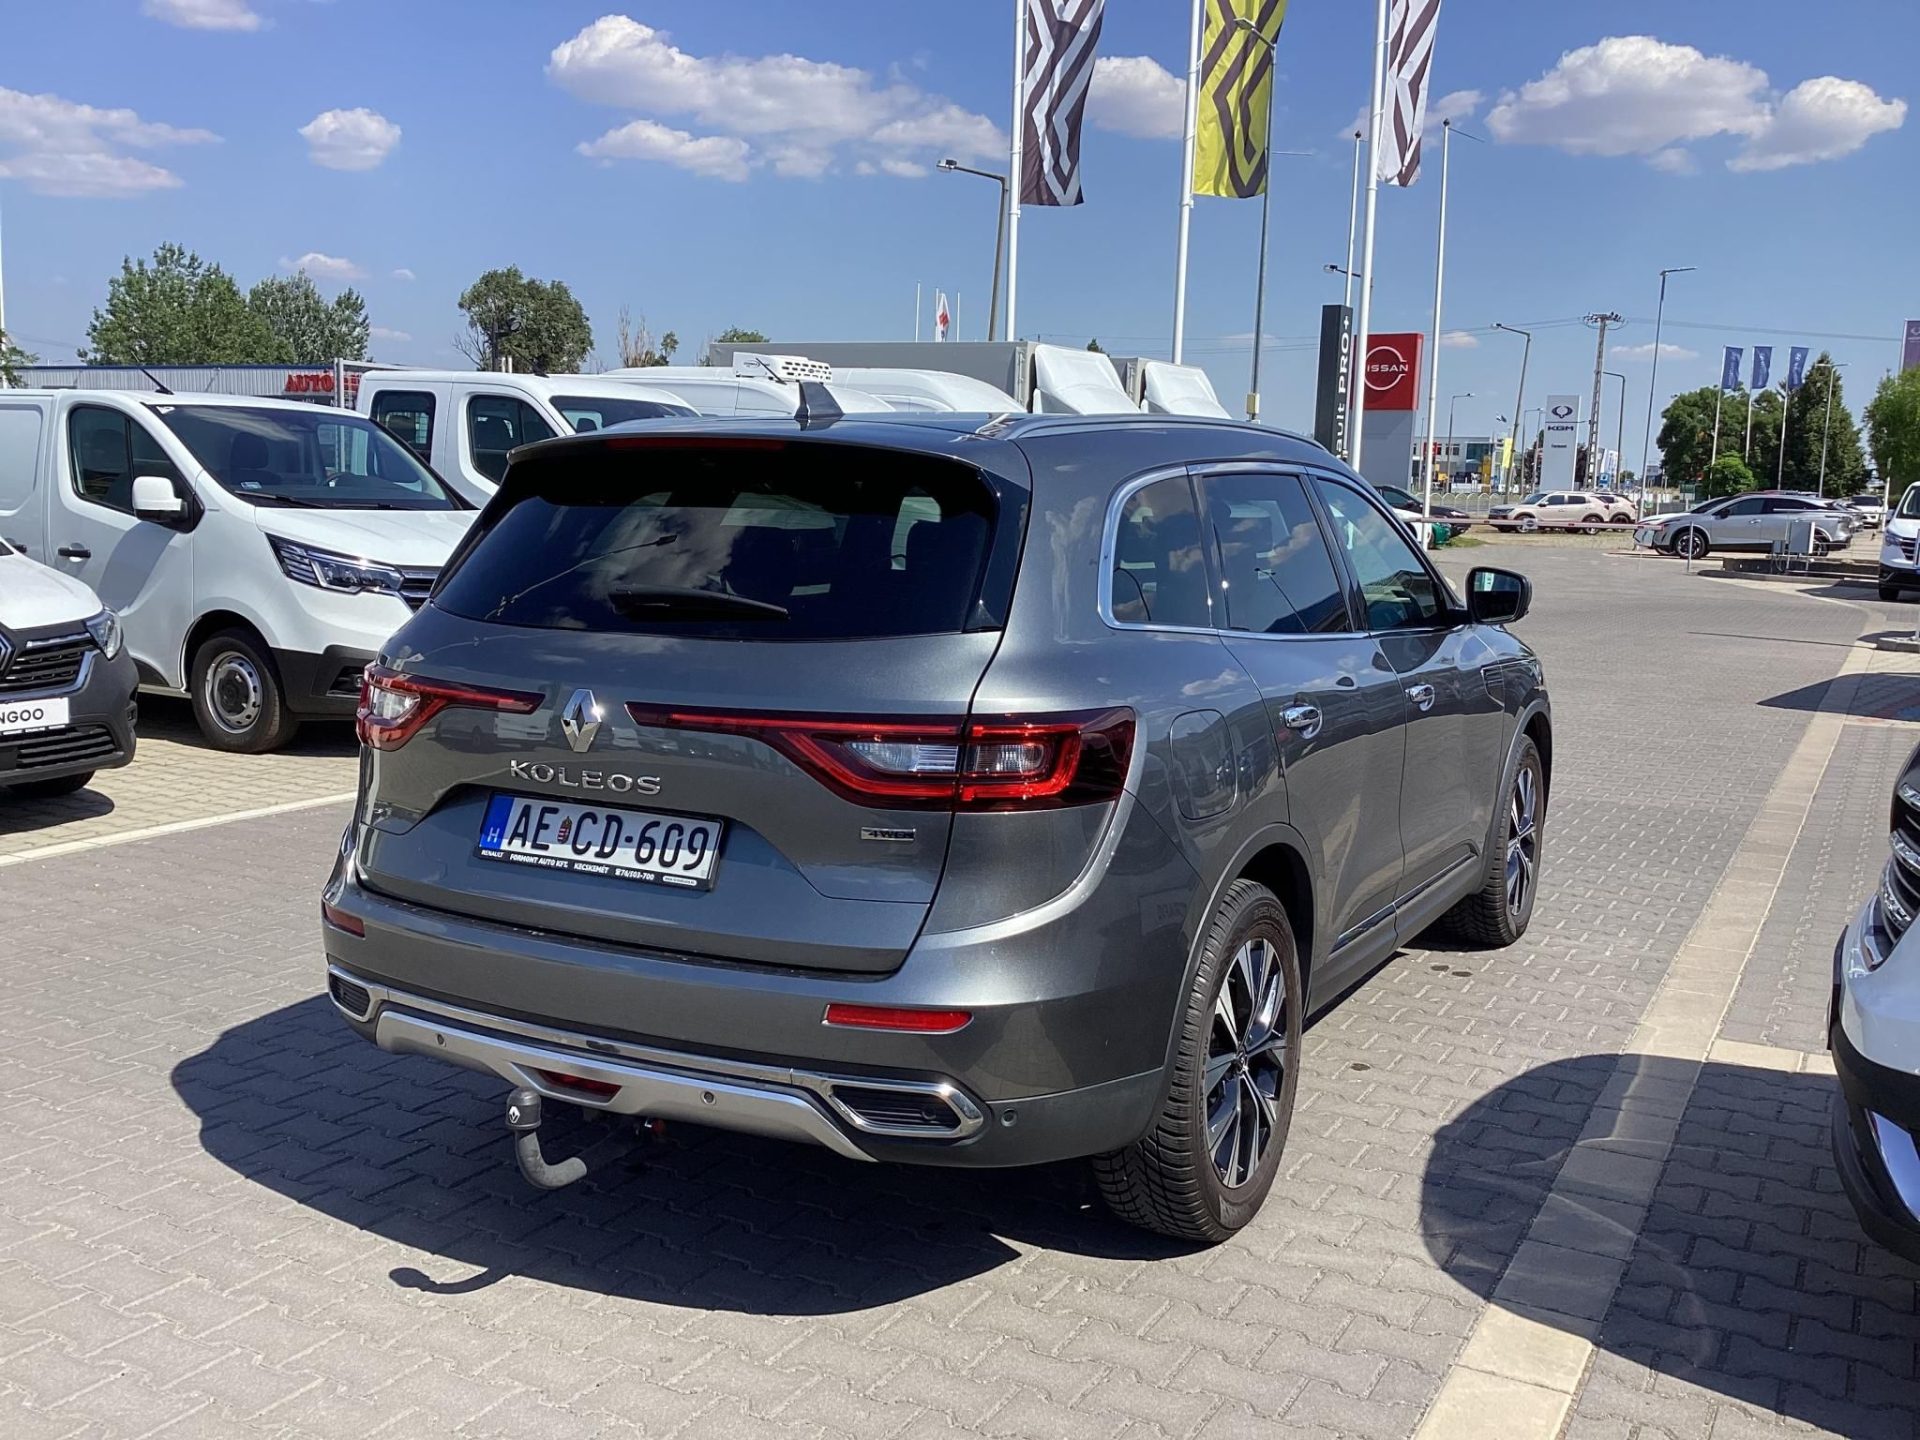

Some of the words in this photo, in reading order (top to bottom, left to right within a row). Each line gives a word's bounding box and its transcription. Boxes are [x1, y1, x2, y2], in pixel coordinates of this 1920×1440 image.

[1338, 315, 1350, 393] PRO+
[1367, 364, 1409, 372] ISSAN
[1335, 402, 1346, 459] ault
[510, 759, 661, 795] KOLEOS
[487, 826, 500, 843] H
[507, 804, 560, 851] AE
[571, 811, 710, 871] CD-609
[481, 849, 504, 858] RENAULT
[510, 853, 539, 864] FORMONT
[539, 857, 555, 867] AUTO
